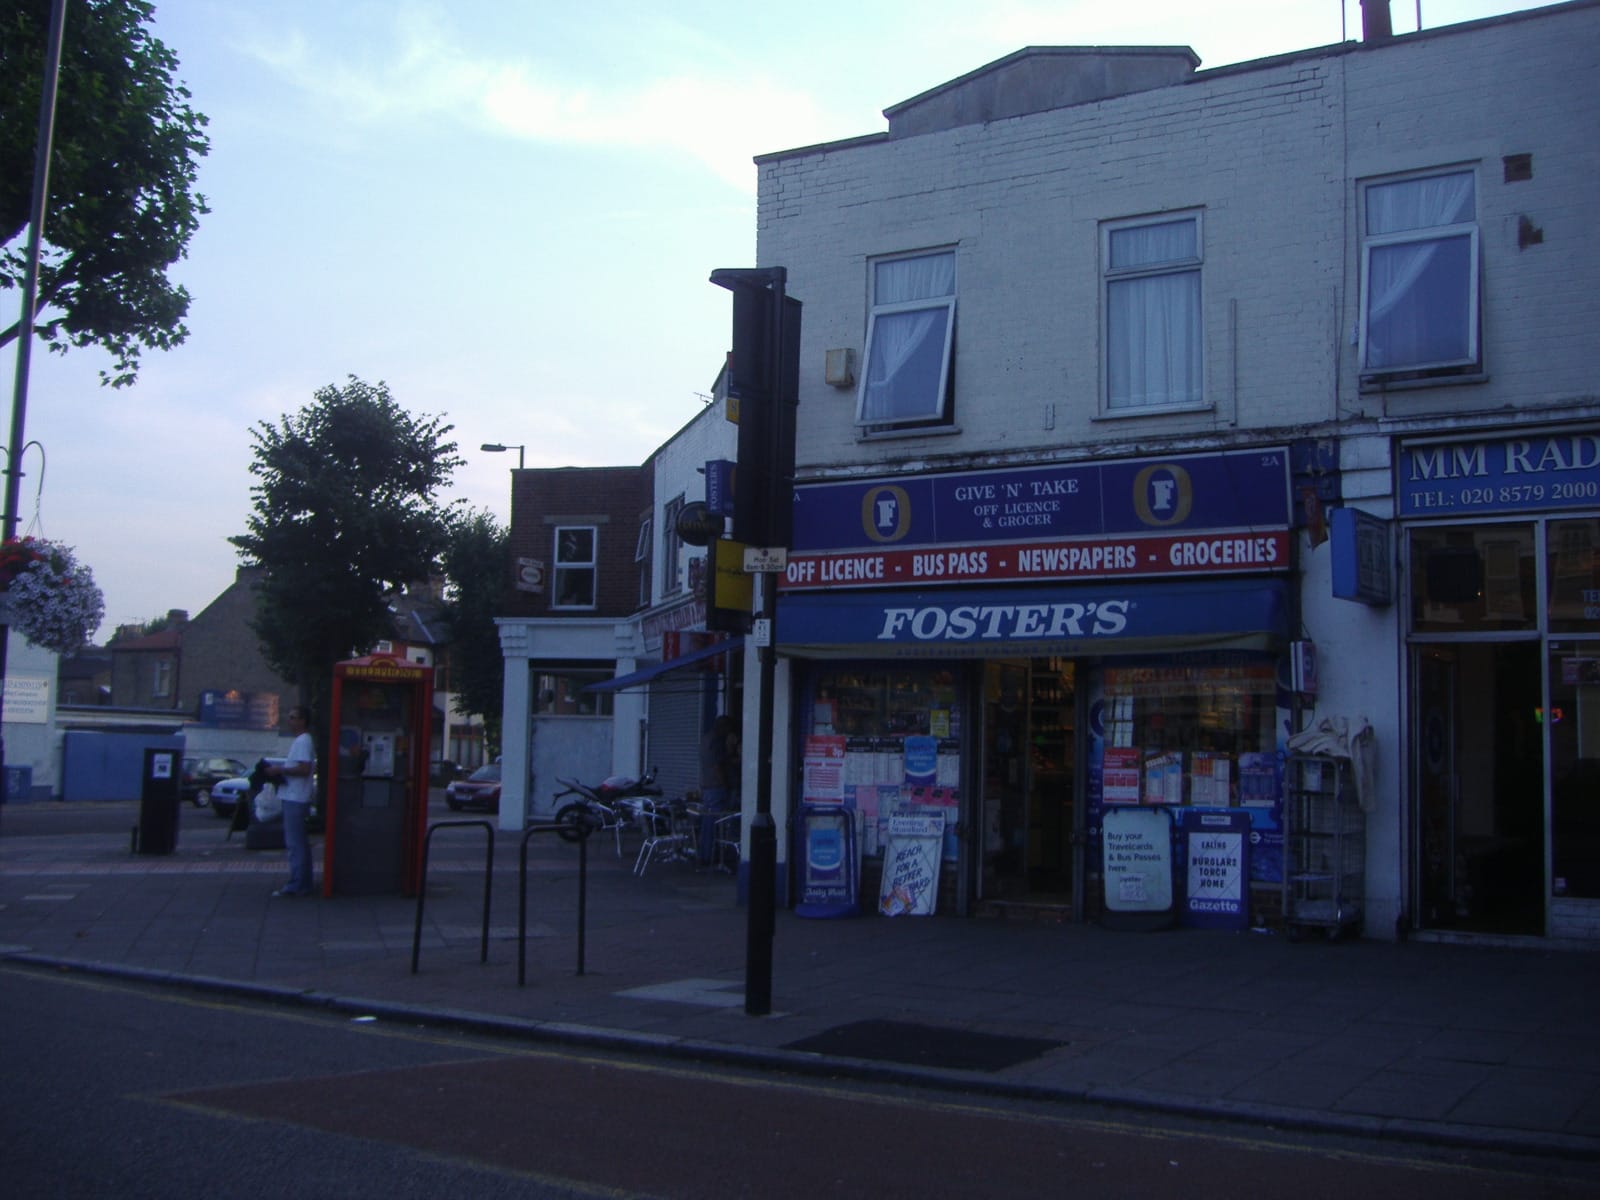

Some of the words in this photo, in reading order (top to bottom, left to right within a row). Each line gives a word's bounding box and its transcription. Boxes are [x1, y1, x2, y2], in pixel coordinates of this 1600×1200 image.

[1261, 455, 1280, 468] 2A
[1409, 443, 1489, 481] MM
[955, 483, 997, 502] GIVE
[1030, 478, 1079, 497] TAKE
[1410, 490, 1455, 509] TEL:
[1460, 488, 1494, 505] 020
[1499, 484, 1545, 502] 8579
[1551, 481, 1597, 499] 2000
[973, 504, 1000, 517] OFF
[1004, 501, 1060, 515] LICENCE
[982, 517, 993, 529] &
[997, 513, 1052, 528] GROCER
[786, 561, 815, 583] OFF
[820, 557, 884, 582] LICENCE
[912, 553, 945, 577] BUS
[947, 551, 988, 575] PASS
[1018, 544, 1136, 572] NEWSPAPERS
[1169, 538, 1277, 567] GROCERIES
[877, 600, 1130, 640] FOSTER'S
[1107, 832, 1122, 841] Buy
[1125, 833, 1143, 841] your
[1108, 842, 1153, 851] Travelcards
[1117, 853, 1132, 862] Bus
[1134, 853, 1161, 862] Passes
[1192, 857, 1237, 867] BURGLARS
[1108, 864, 1127, 873] here
[1199, 867, 1227, 877] TORCH
[1200, 879, 1225, 889] HOME
[1189, 899, 1239, 913] Gazette
